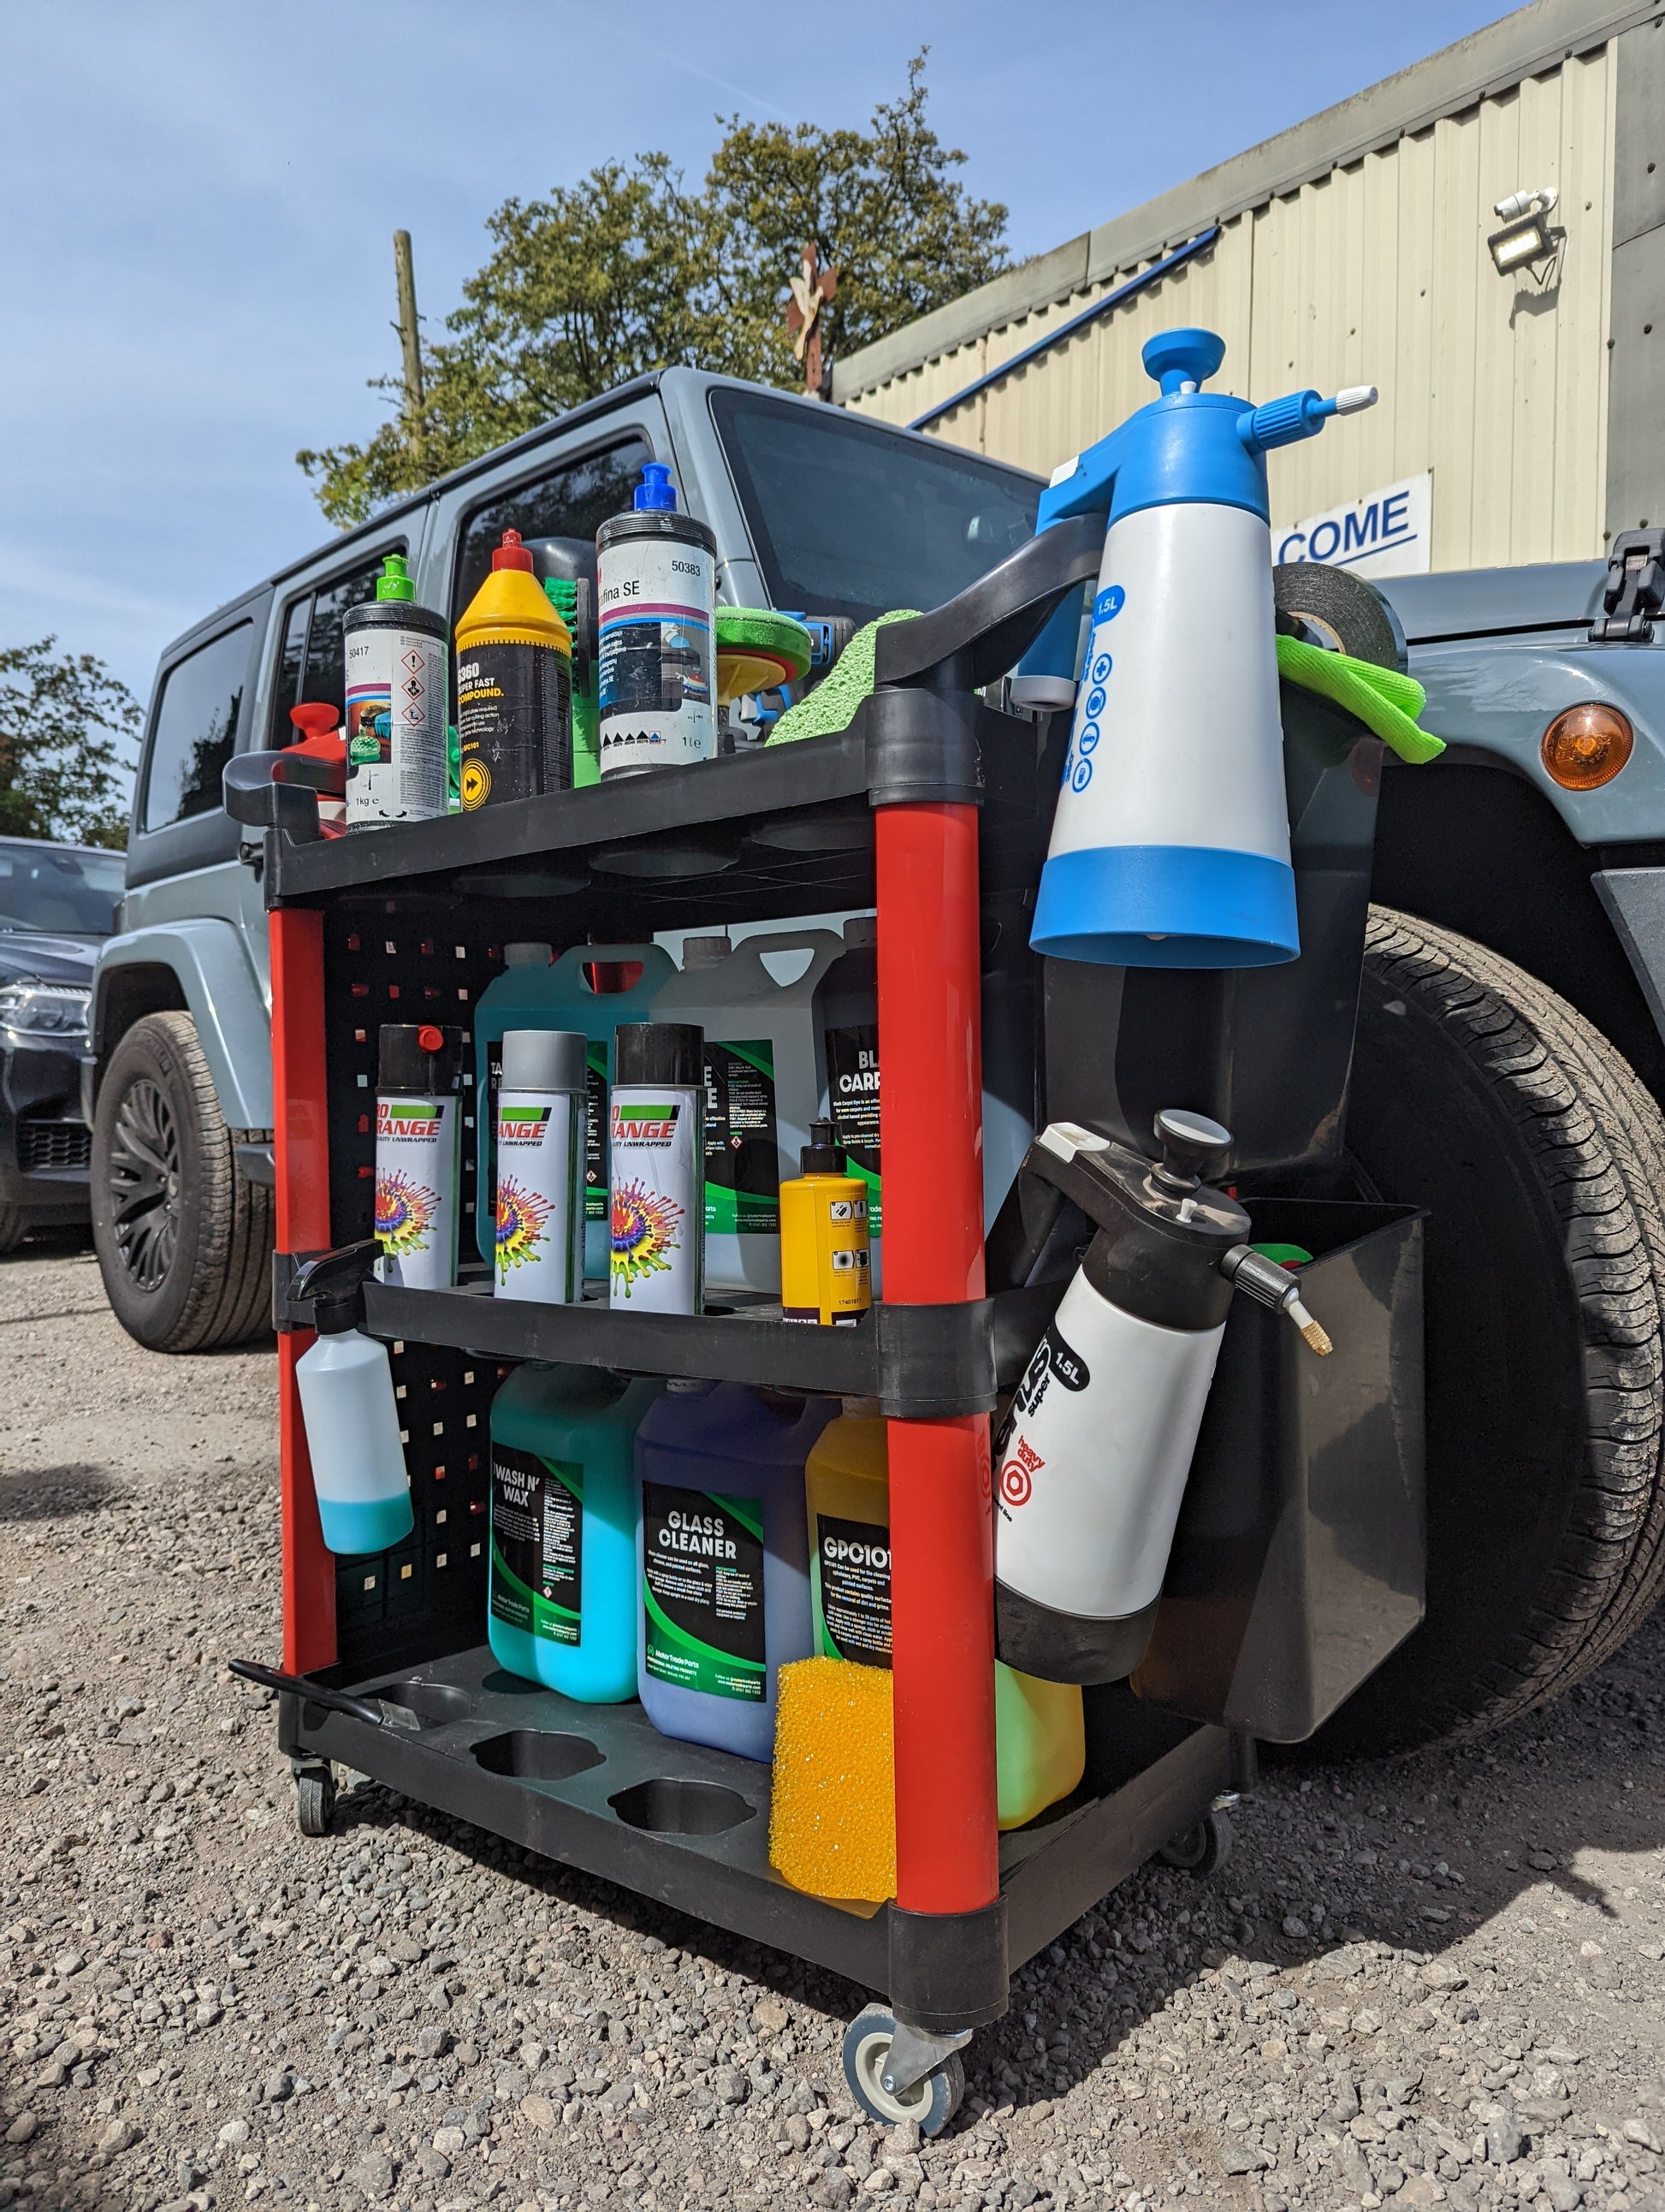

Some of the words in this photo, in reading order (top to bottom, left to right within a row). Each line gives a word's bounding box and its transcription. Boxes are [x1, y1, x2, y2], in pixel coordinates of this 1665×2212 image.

[1278, 490, 1410, 563] COME
[672, 560, 701, 577] 50383
[623, 580, 640, 596] SE
[1098, 596, 1117, 615] 1.5L
[349, 645, 369, 659] 50417
[474, 677, 495, 688] FAST
[356, 798, 369, 807] 1kg
[859, 1050, 880, 1069] BL
[707, 1088, 718, 1109] E
[1055, 1352, 1080, 1385] 1.5L
[1028, 1373, 1051, 1417] super
[1017, 1435, 1046, 1468] heavy
[1017, 1449, 1039, 1473] duty
[496, 1463, 525, 1488] WASH
[503, 1484, 529, 1507] WAX
[668, 1510, 725, 1537] GLASS
[659, 1528, 737, 1559] CLEANER
